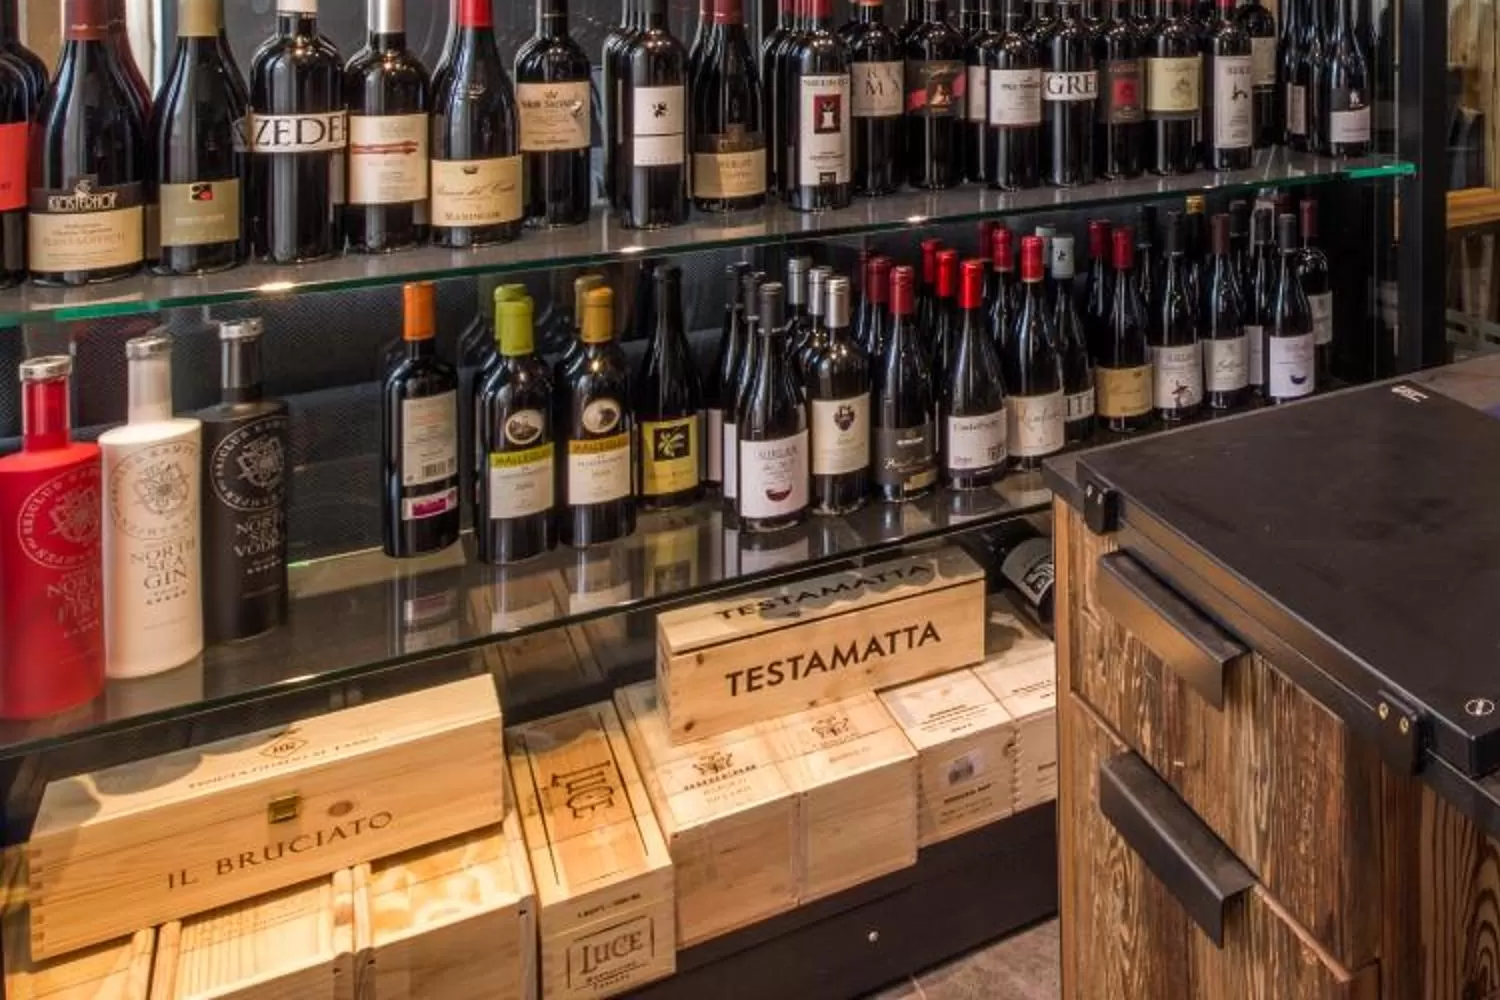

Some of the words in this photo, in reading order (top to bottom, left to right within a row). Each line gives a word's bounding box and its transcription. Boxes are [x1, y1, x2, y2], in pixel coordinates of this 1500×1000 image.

[131, 538, 196, 565] NORTH
[146, 555, 186, 574] SEA
[143, 566, 190, 591] GIN
[714, 562, 936, 622] TESTAMATTA
[724, 620, 942, 697] TESTAMATTA
[167, 870, 199, 893] IL
[215, 809, 395, 877] BRUCIATO
